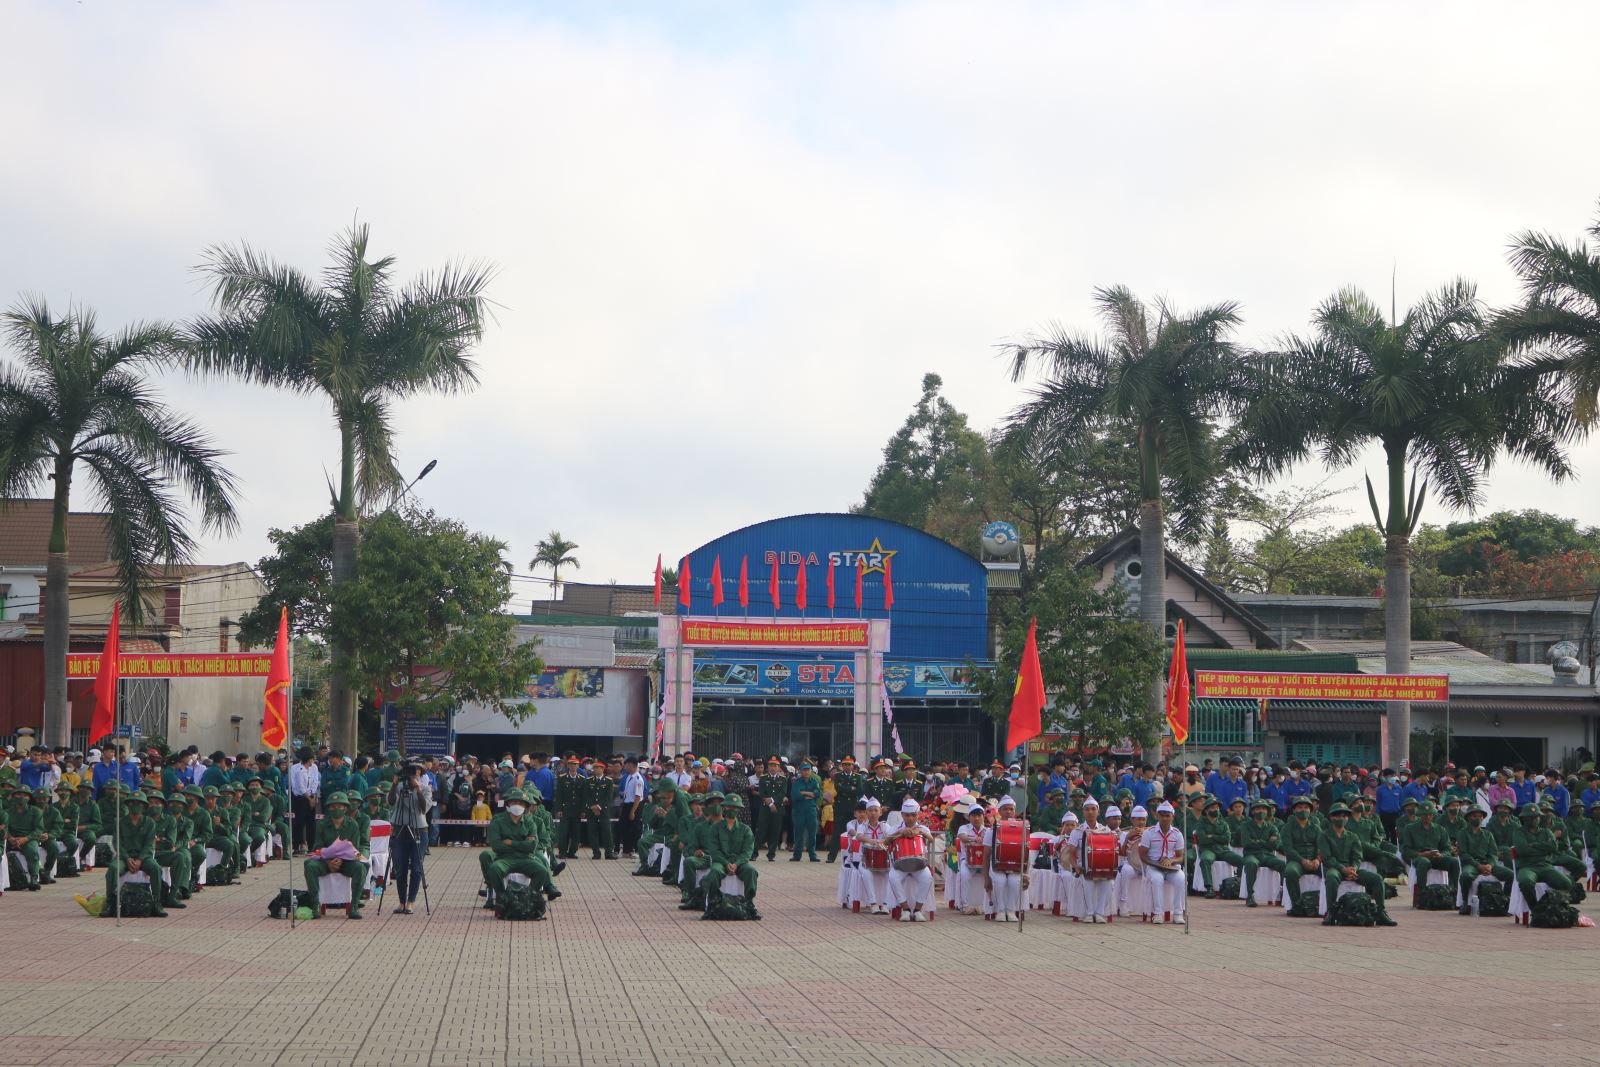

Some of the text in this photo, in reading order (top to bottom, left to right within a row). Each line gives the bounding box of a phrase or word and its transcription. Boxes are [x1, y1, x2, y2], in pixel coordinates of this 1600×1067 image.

[764, 550, 882, 567] BIDA STAR
[821, 626, 833, 641] BẢO
[833, 626, 841, 645] VỆ
[849, 625, 864, 643] QUỐC
[69, 656, 82, 674] BẢO
[83, 657, 91, 677] VỆ
[119, 657, 127, 674] LÀ
[151, 657, 170, 674] NGHĨA
[184, 656, 204, 673] TRÁCH
[205, 656, 225, 677] NHIỆM
[226, 655, 239, 673] CỦA
[240, 659, 253, 677] MỌI
[254, 656, 271, 673] CÔNG
[797, 664, 855, 683] STA
[1198, 673, 1216, 683] TIẾP
[1218, 674, 1241, 684] BƯỚC
[1242, 675, 1260, 684] CHA
[1262, 675, 1280, 684] ANH
[1282, 674, 1300, 685] TUỔI
[1302, 675, 1318, 685] TRẺ
[1319, 676, 1347, 687] HUYỆN
[1380, 678, 1398, 687] ANA
[1400, 676, 1416, 687] LÊN
[1417, 676, 1447, 688] ĐƯỜNG
[1205, 685, 1437, 700] NHẬP NGŨ QUYẾT TÂM HOÀN THÀNH XUẤT SẮC NHIỆM VỤ
